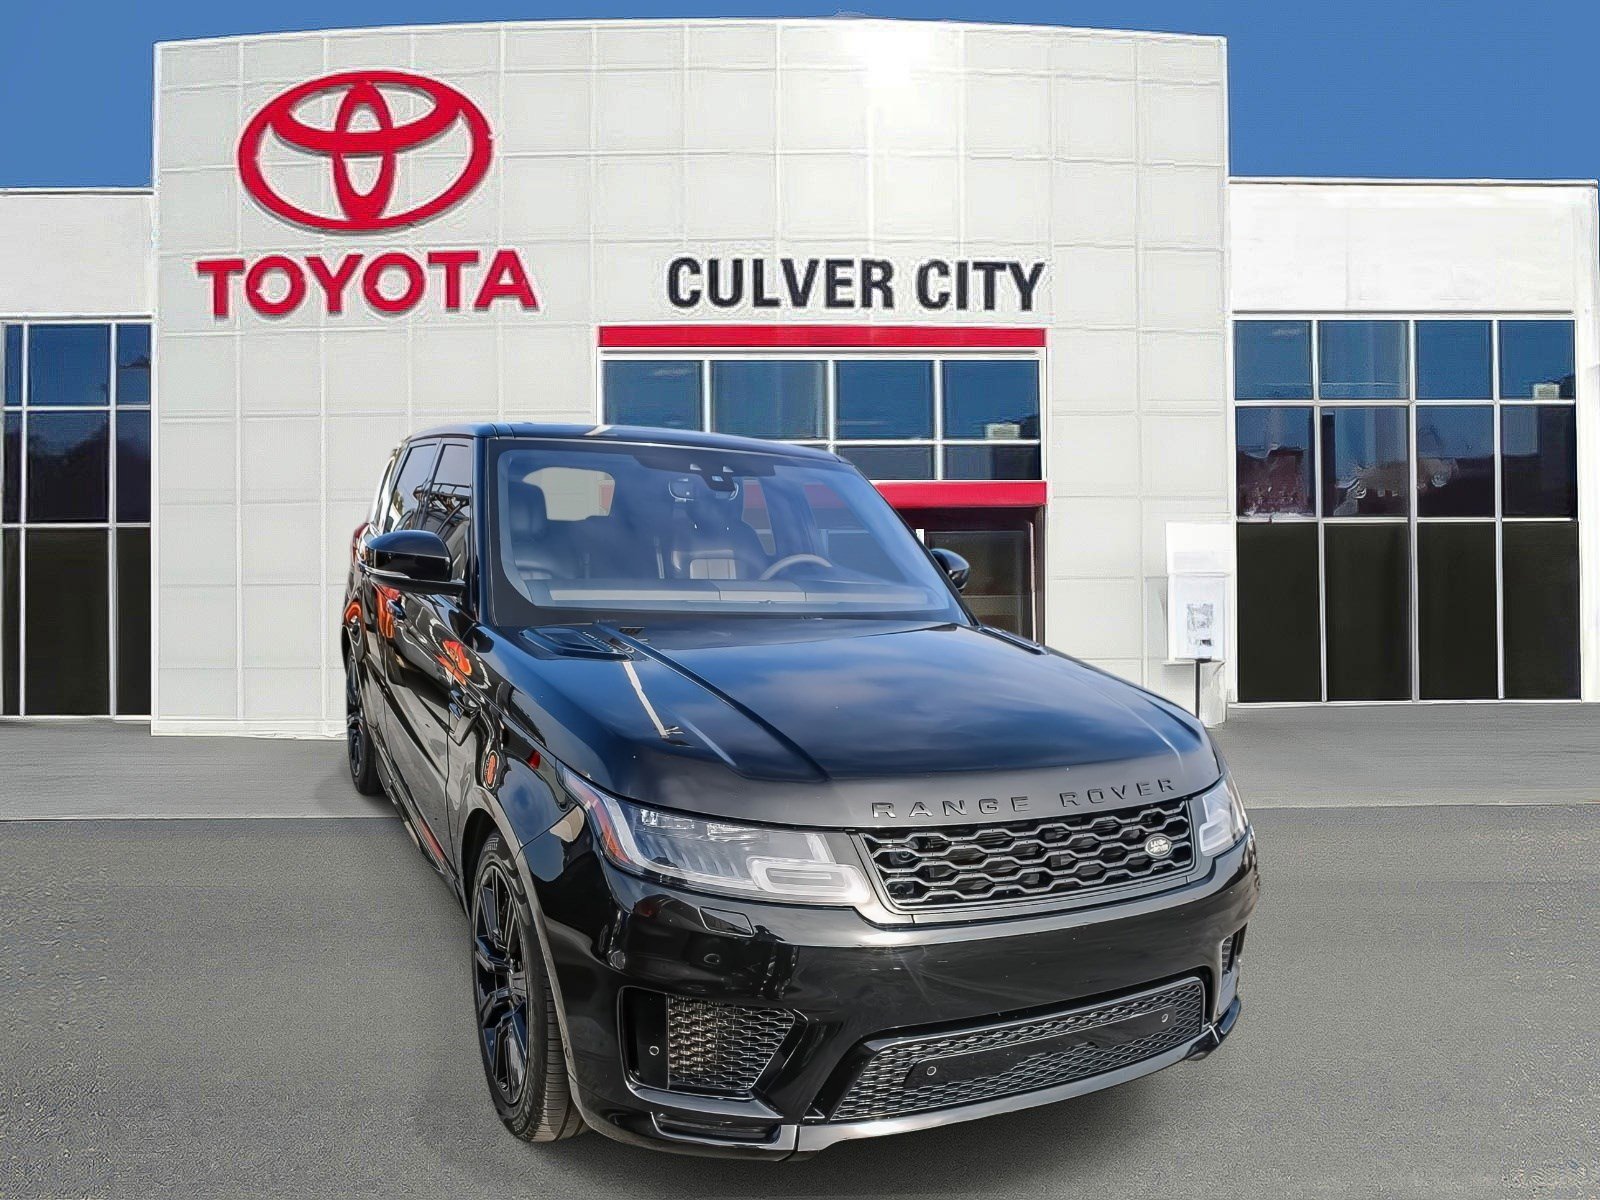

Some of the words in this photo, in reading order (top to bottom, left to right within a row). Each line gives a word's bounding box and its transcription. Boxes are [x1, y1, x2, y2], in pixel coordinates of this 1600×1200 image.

[196, 249, 539, 318] TOYOTA
[667, 257, 895, 309] CULVER
[915, 259, 1046, 311] CITY
[871, 796, 1030, 818] RANGE
[1059, 779, 1175, 807] ROVER
